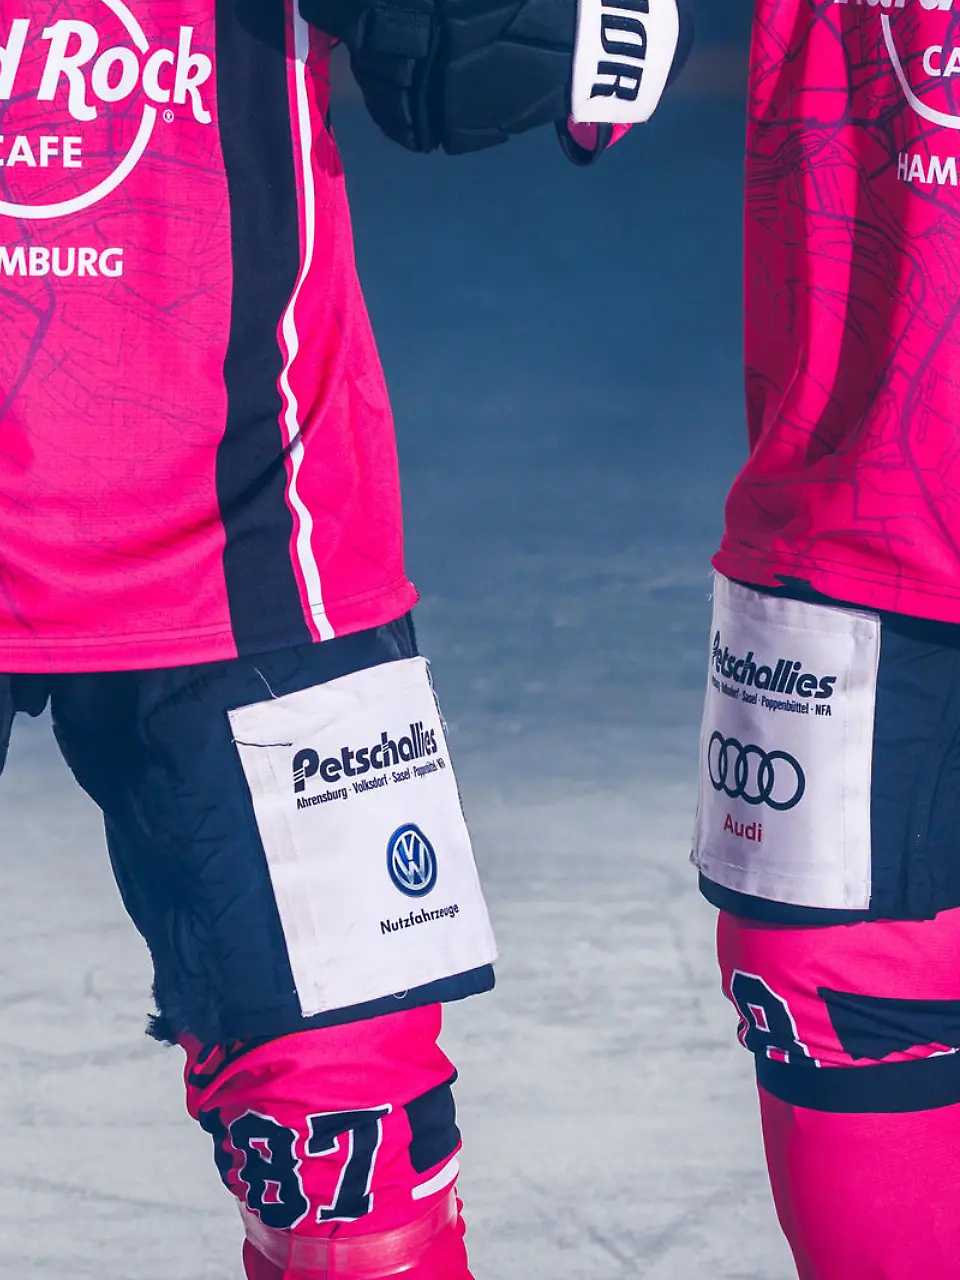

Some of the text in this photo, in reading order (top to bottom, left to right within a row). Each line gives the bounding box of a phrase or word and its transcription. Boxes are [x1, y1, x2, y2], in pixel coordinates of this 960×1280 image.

[36, 19, 213, 124] Rock
[815, 704, 832, 717] NFA
[292, 720, 438, 794] Petschallies
[296, 787, 348, 810] Ahrensburg
[352, 776, 388, 795] Volksdorf
[391, 767, 411, 783] Sasel
[723, 813, 763, 843] Audi
[379, 903, 460, 935] Nutzfahrzeuge
[229, 1103, 393, 1230] 87
